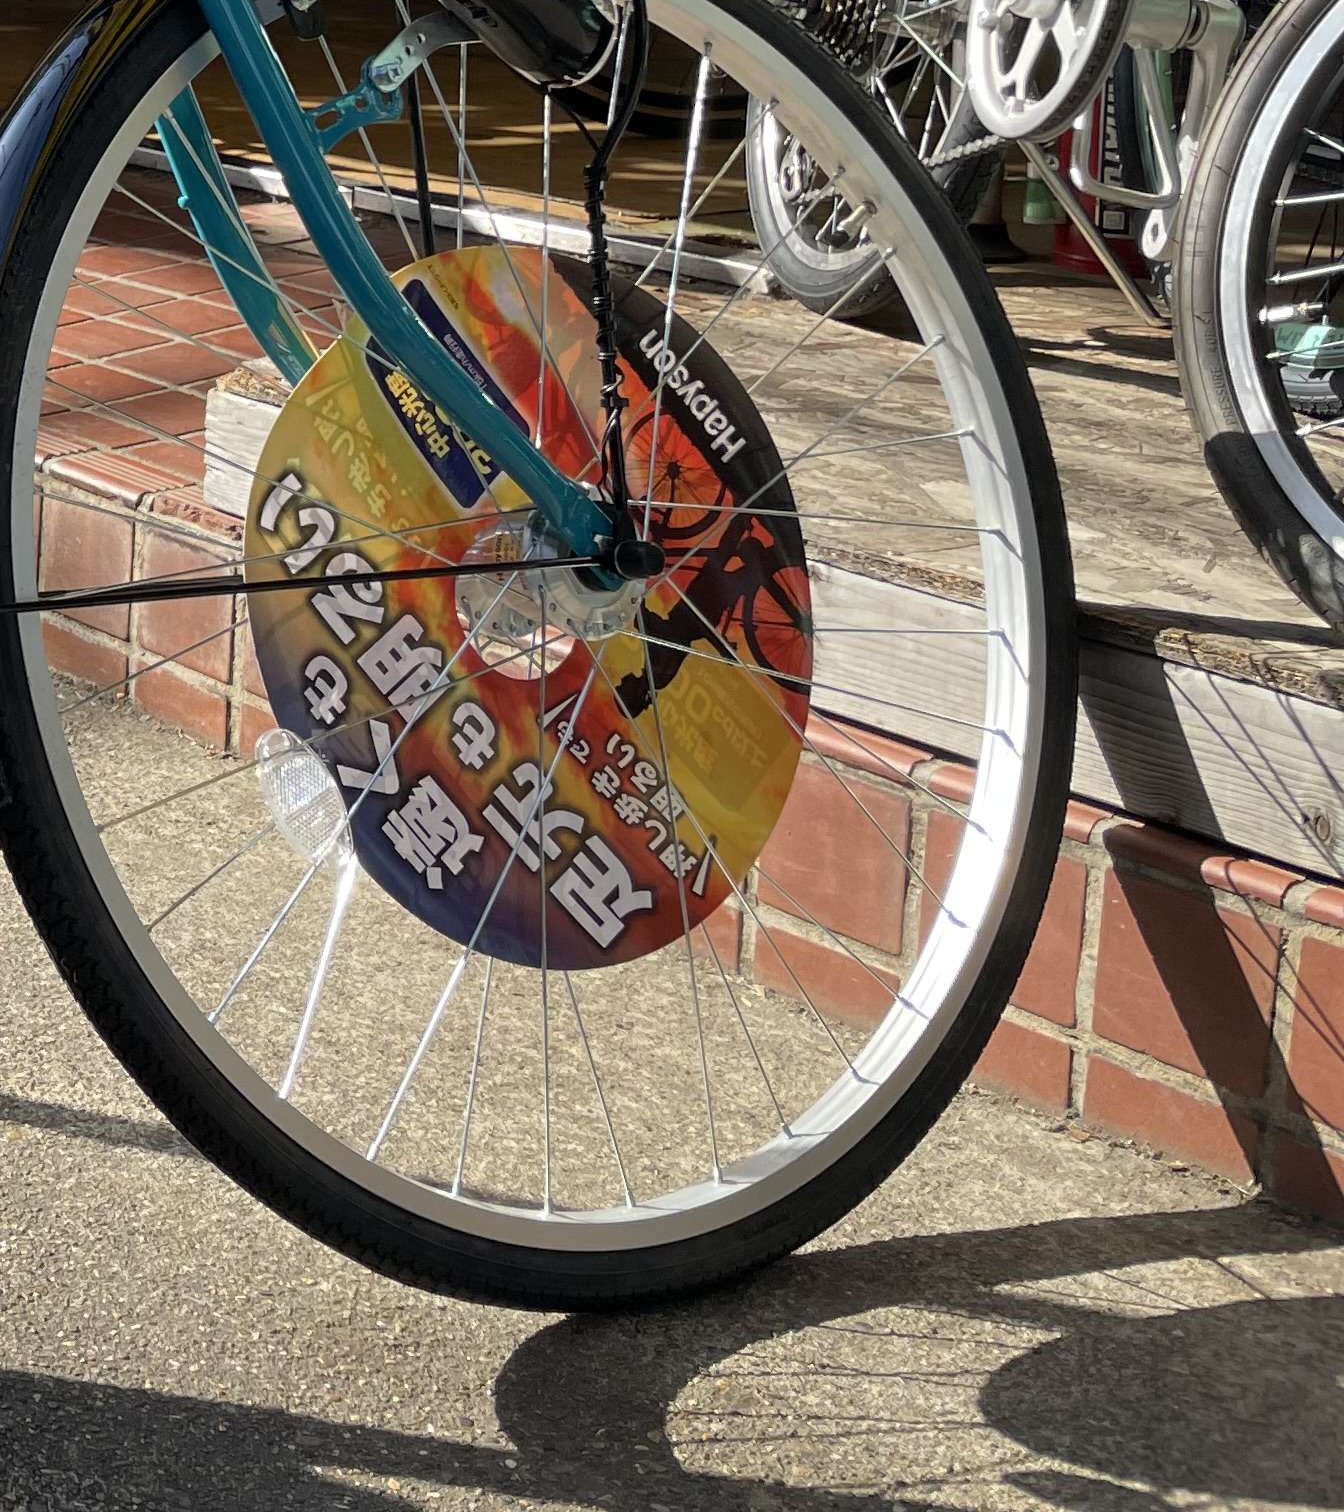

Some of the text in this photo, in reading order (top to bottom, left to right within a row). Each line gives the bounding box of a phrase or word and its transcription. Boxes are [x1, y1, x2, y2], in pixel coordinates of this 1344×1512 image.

[383, 368, 456, 463] 中心光度
[639, 327, 746, 464] Hapyson
[260, 473, 654, 949] 足元も明るい
[303, 656, 487, 892] 遠くも
[606, 730, 688, 823] 明るい
